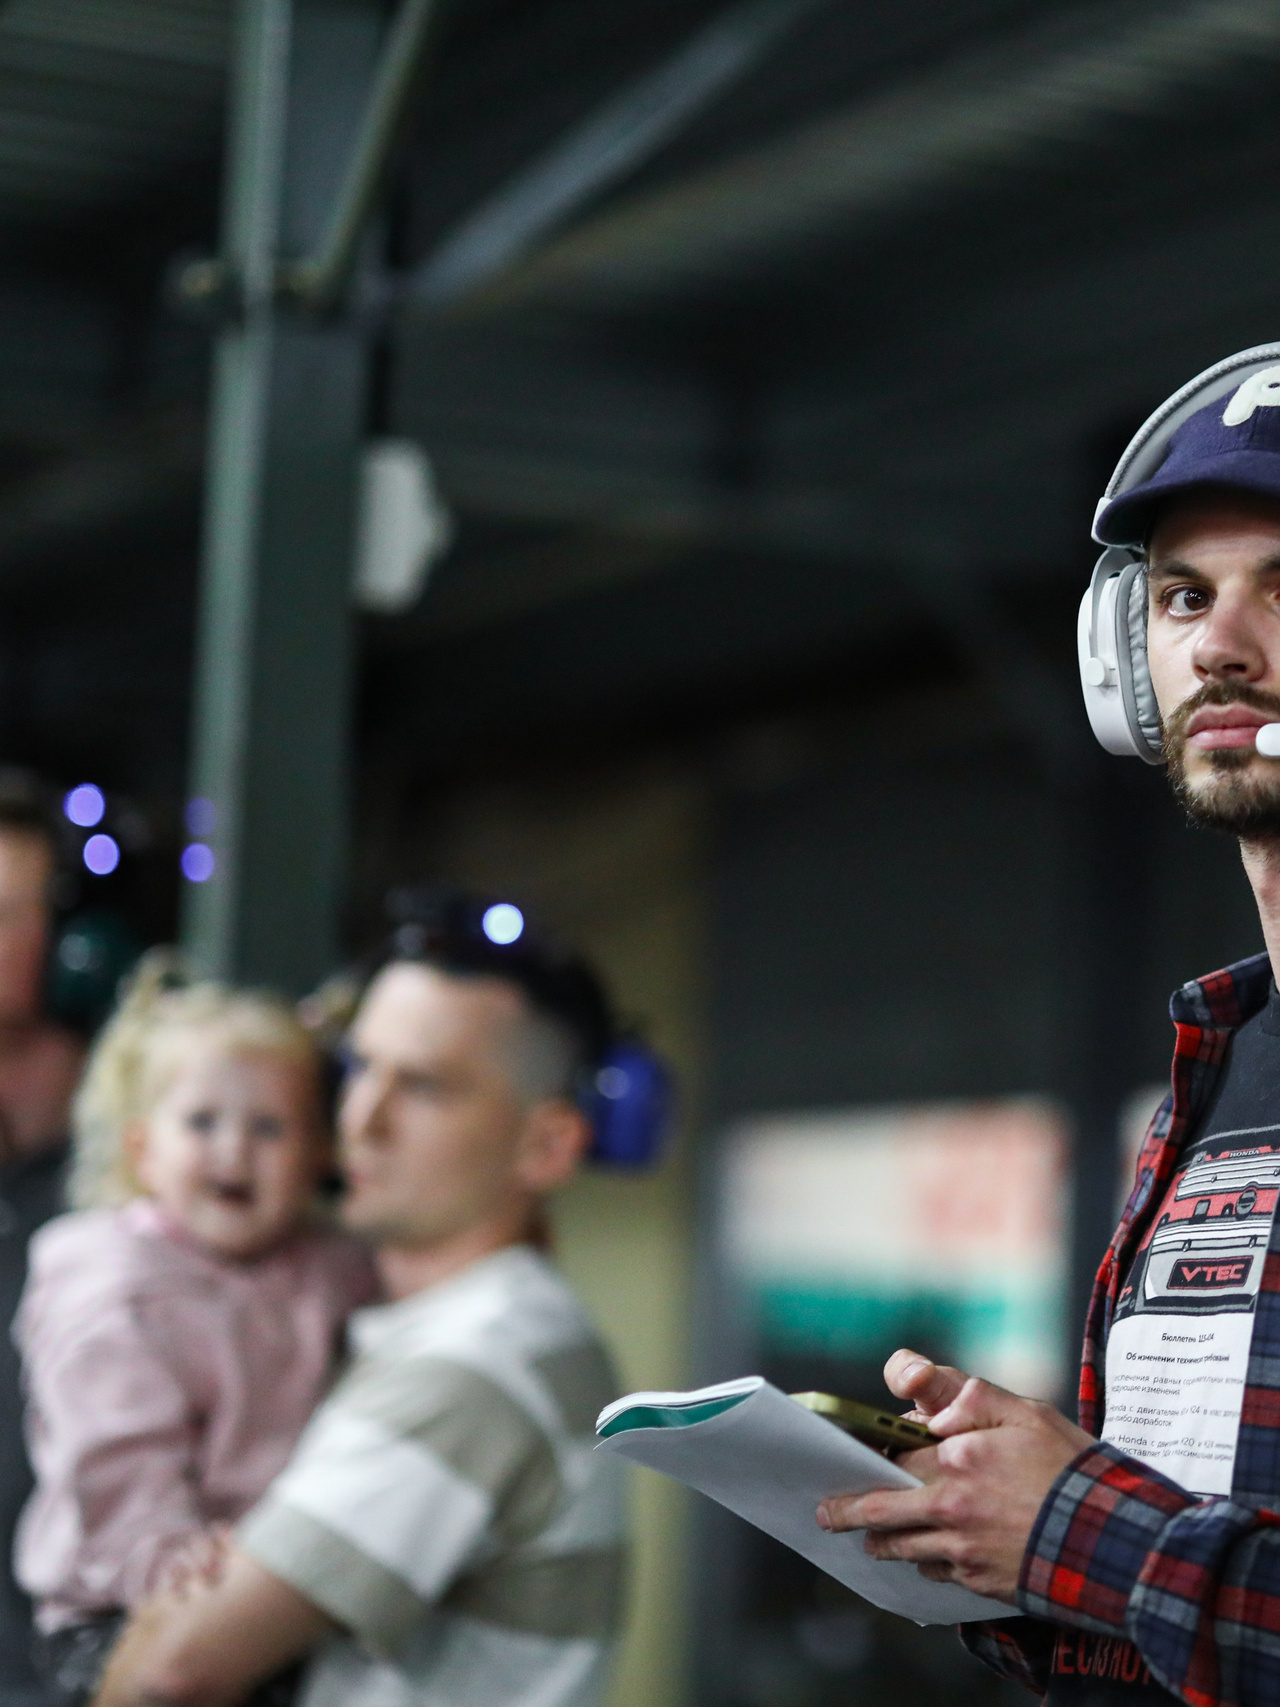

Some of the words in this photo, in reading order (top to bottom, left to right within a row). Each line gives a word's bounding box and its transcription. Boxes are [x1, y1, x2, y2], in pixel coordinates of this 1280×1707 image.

[1229, 1149, 1260, 1158] HONDA
[1182, 1264, 1245, 1282] VTEC
[1161, 1332, 1197, 1343] Бюллетень
[1126, 1352, 1137, 1361] Об
[1137, 1355, 1175, 1363] изменении
[1118, 1434, 1148, 1446] Honda
